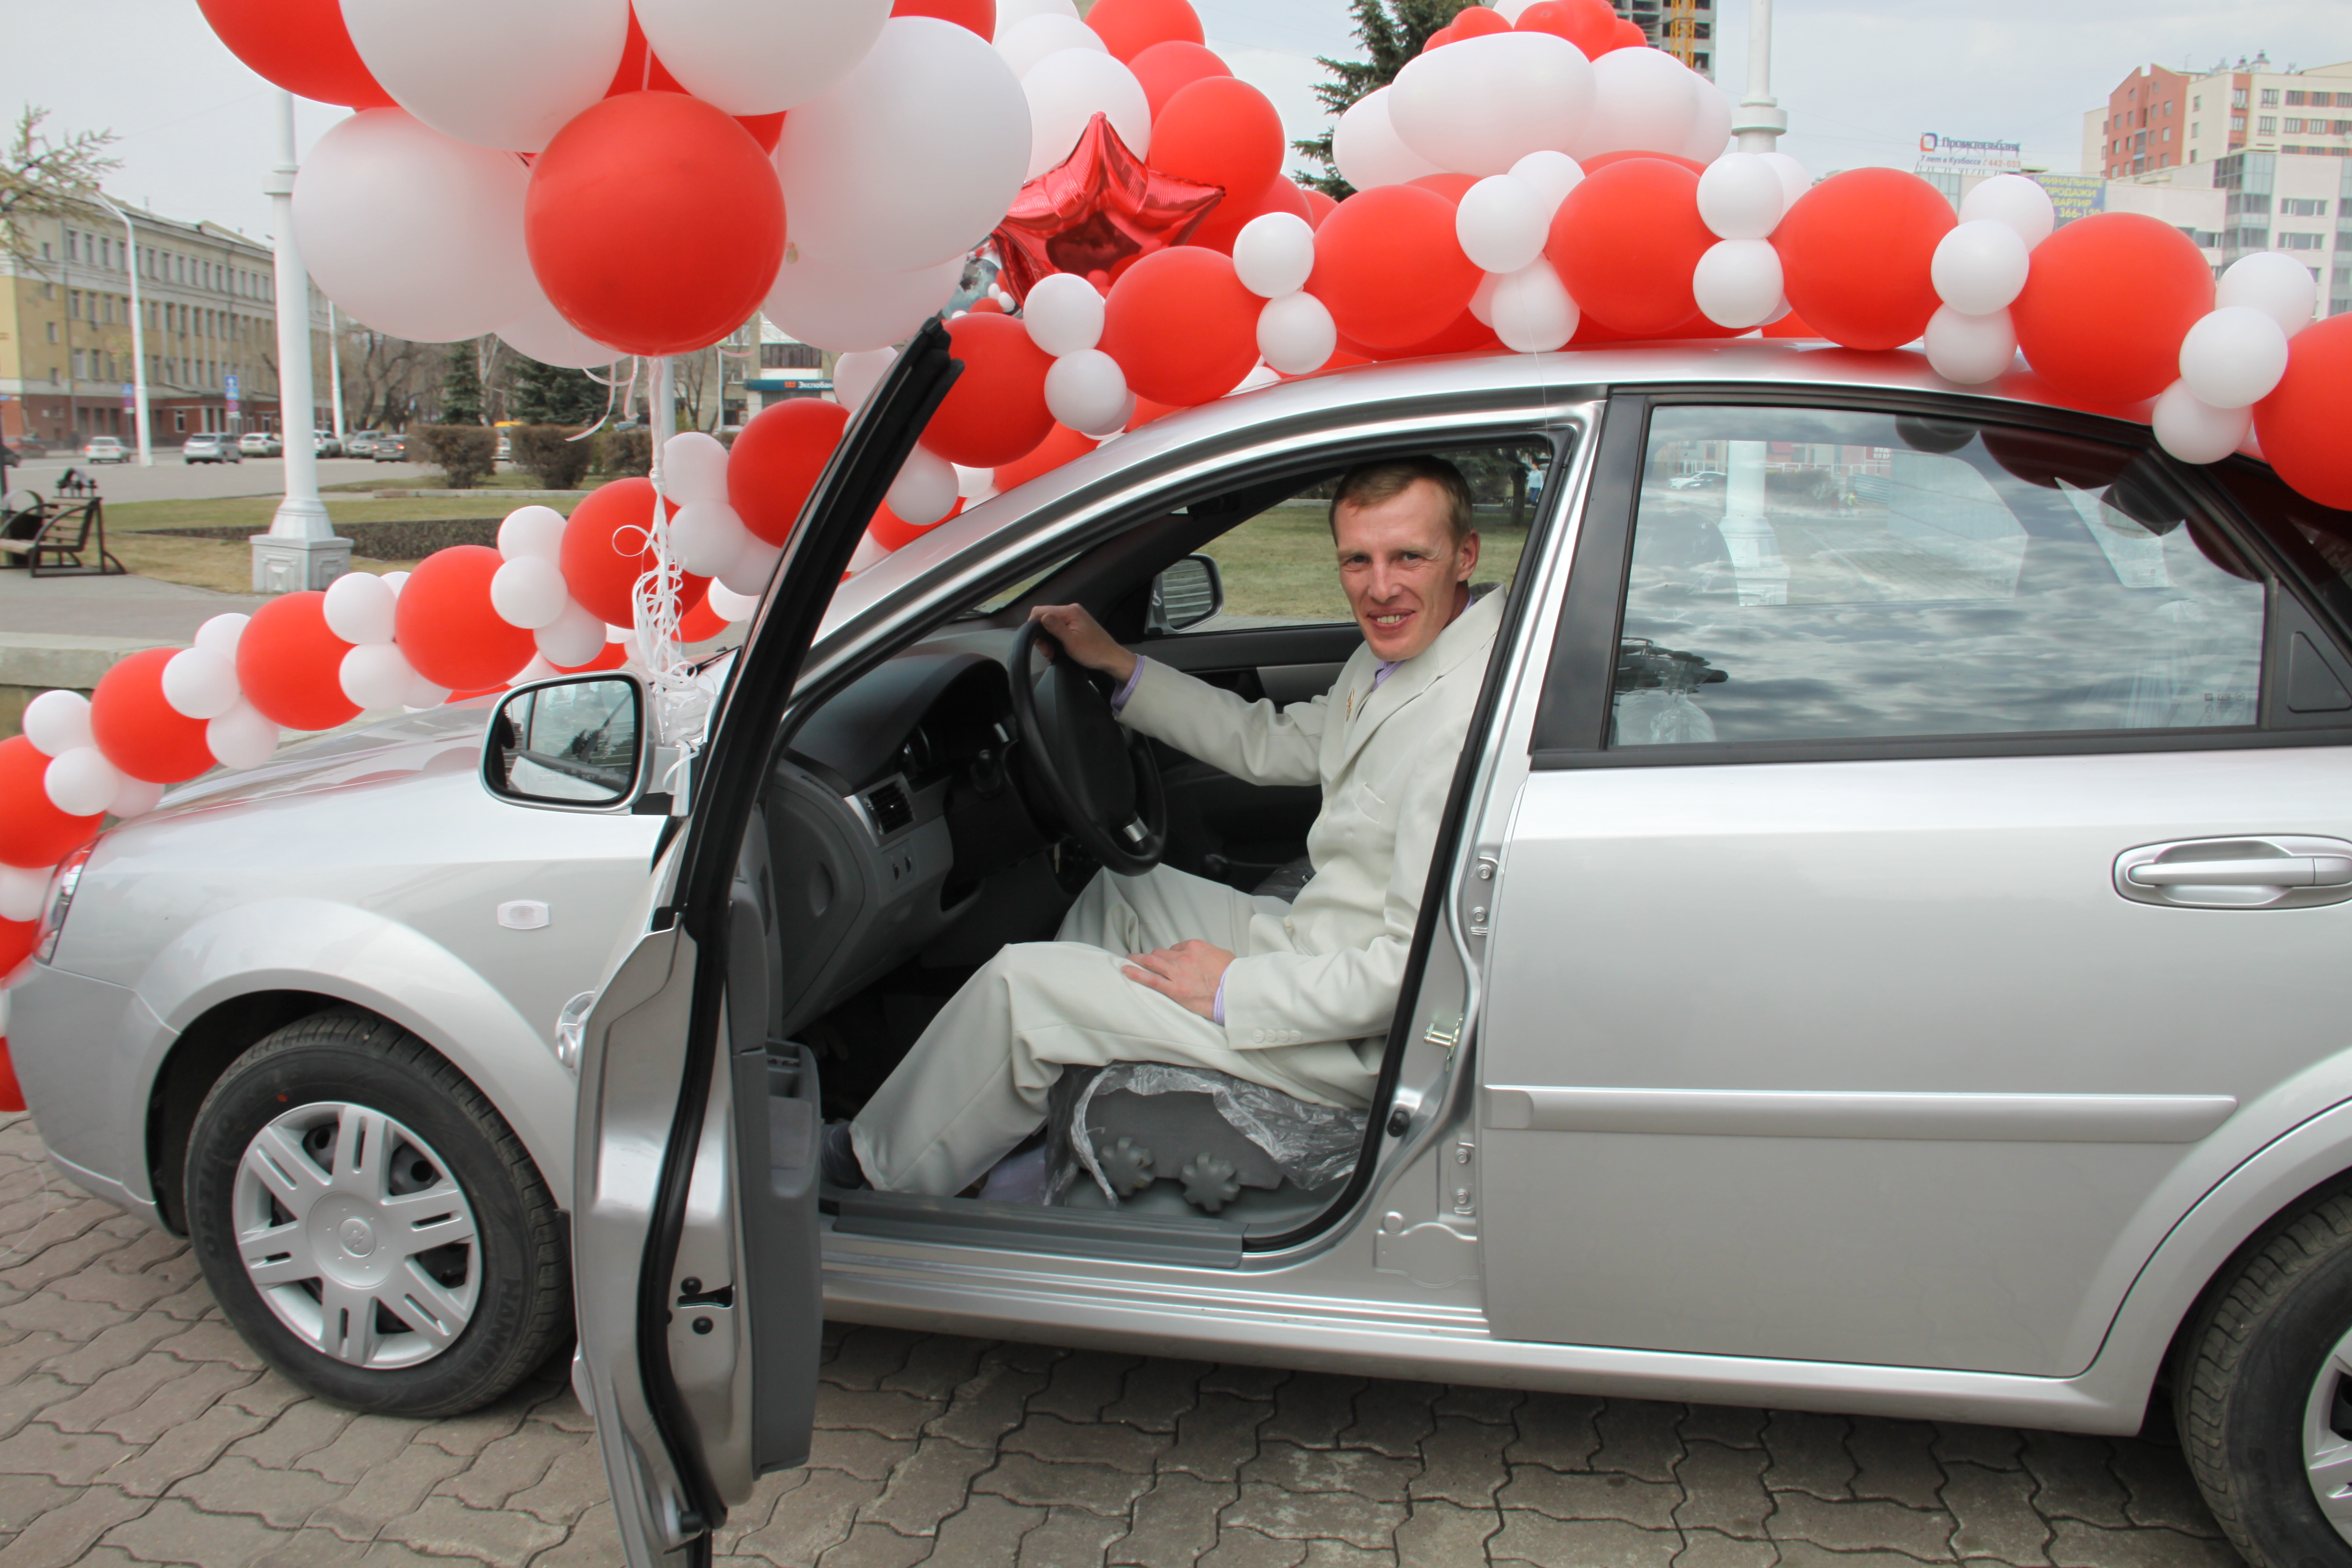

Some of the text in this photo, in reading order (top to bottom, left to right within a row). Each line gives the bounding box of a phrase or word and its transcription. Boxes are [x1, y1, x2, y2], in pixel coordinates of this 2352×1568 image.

[1942, 137, 2020, 151] Промсвязьбанк
[1948, 156, 1981, 166] Кузбассе
[2038, 176, 2103, 188] ФИНАЛЬНЫЕ
